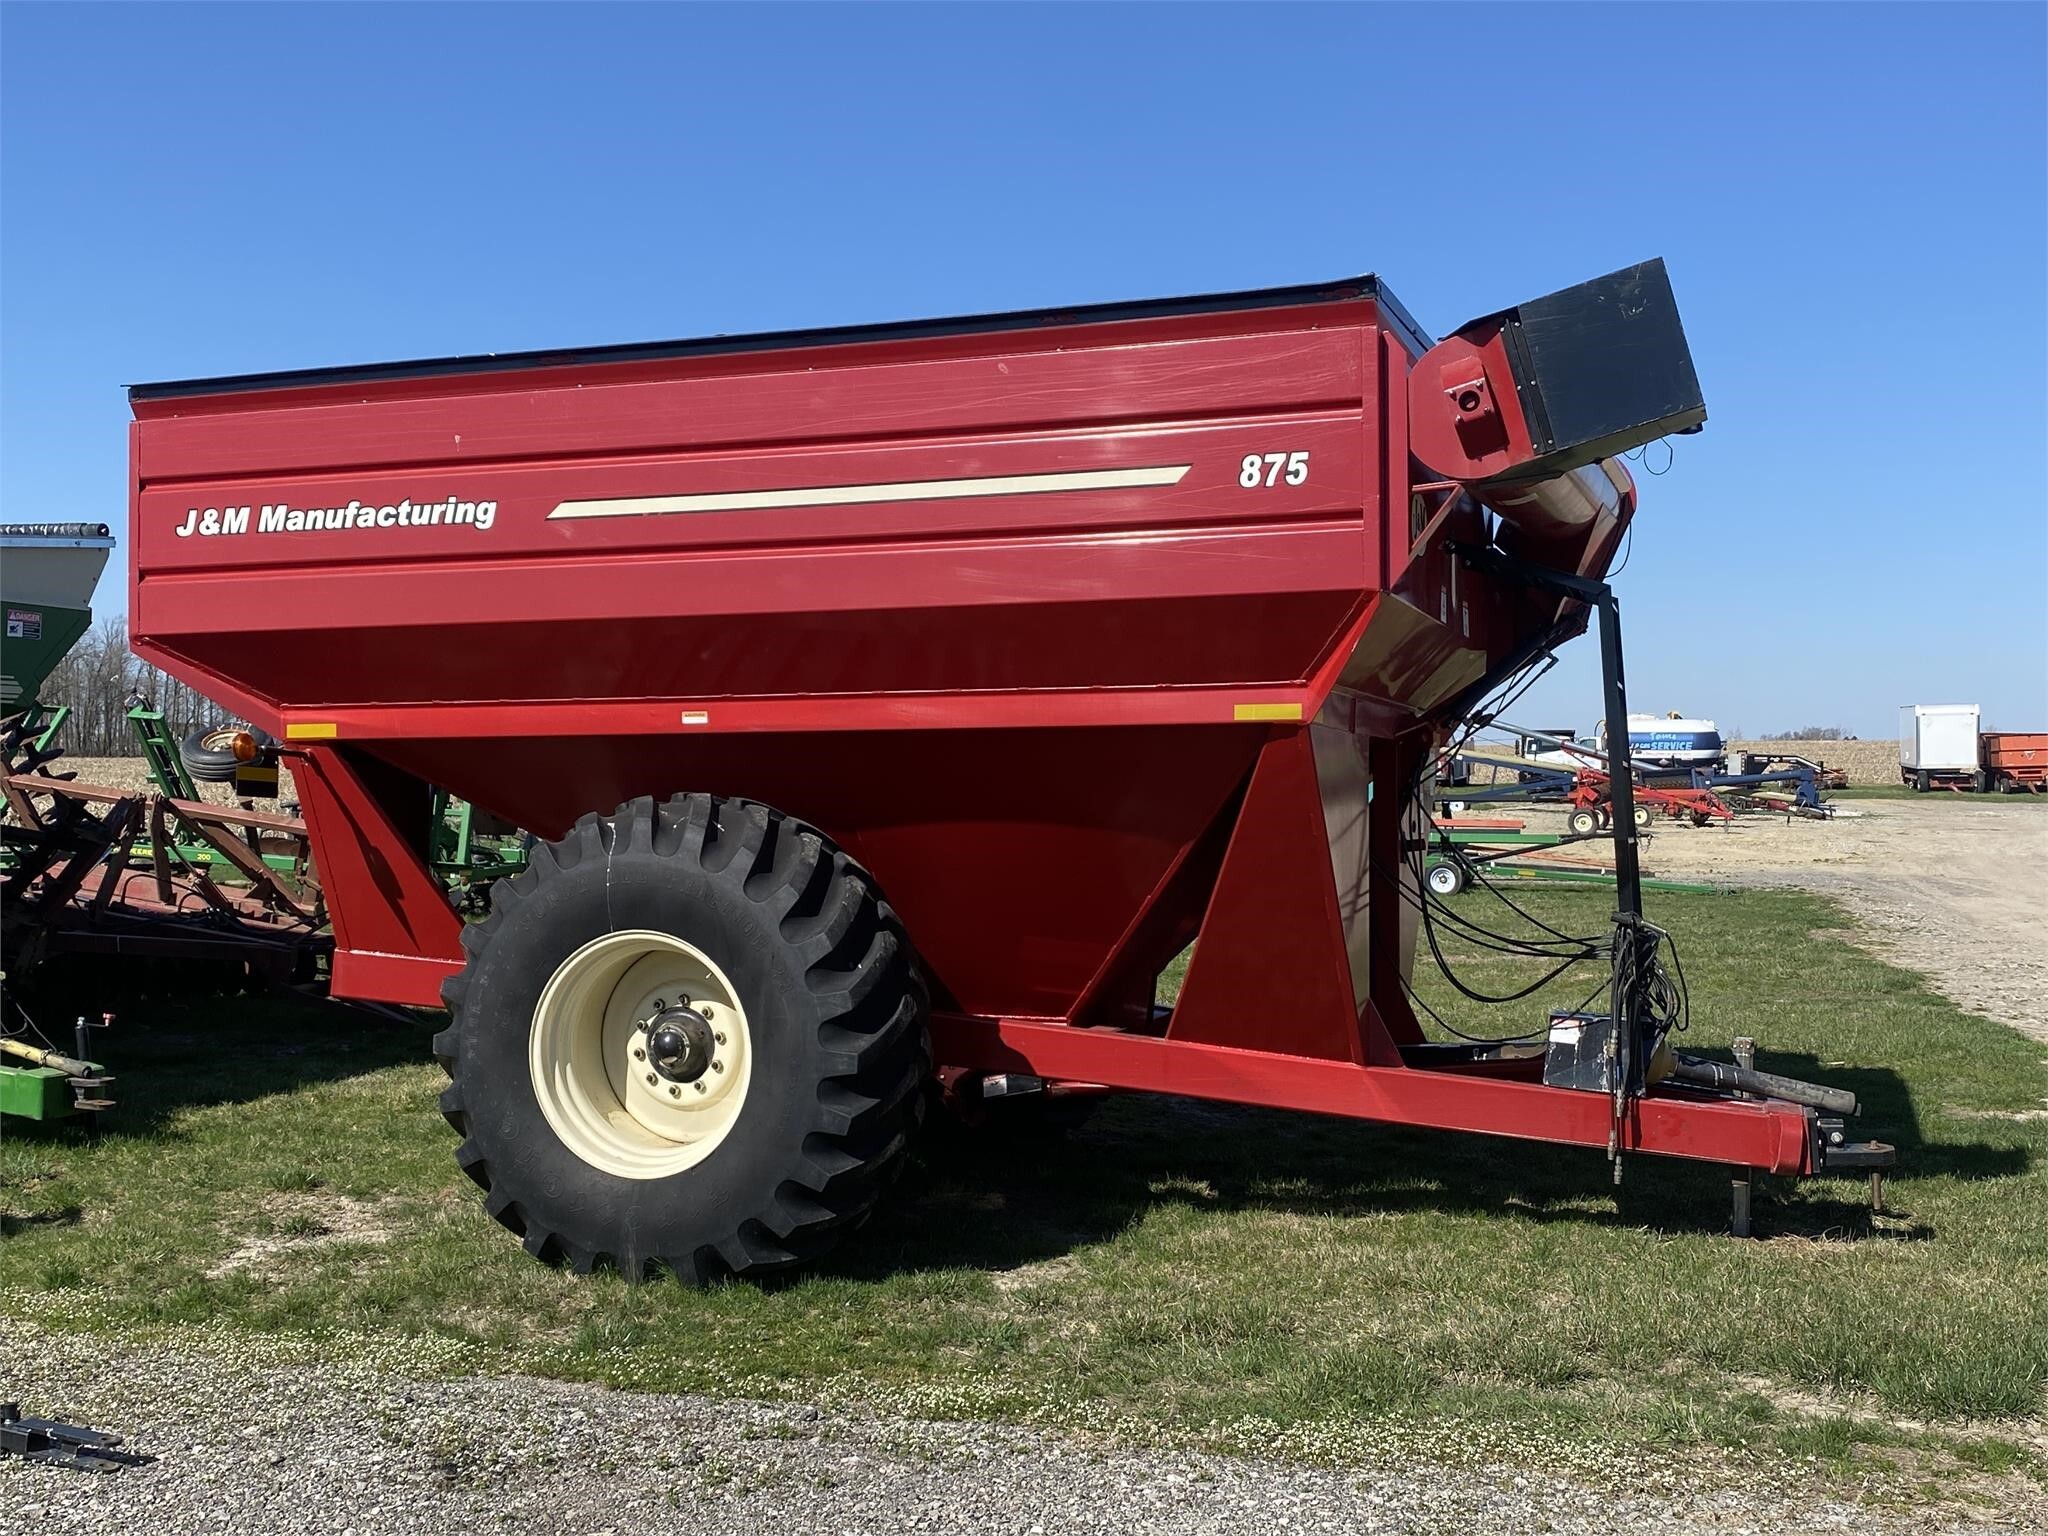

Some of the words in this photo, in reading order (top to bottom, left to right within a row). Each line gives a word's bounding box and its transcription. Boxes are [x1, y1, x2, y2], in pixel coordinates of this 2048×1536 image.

[1239, 450, 1310, 488] 875
[175, 505, 250, 537] J&M
[256, 496, 497, 533] Manufacturing
[1650, 741, 1693, 751] SERVICE
[196, 853, 211, 861] 200
